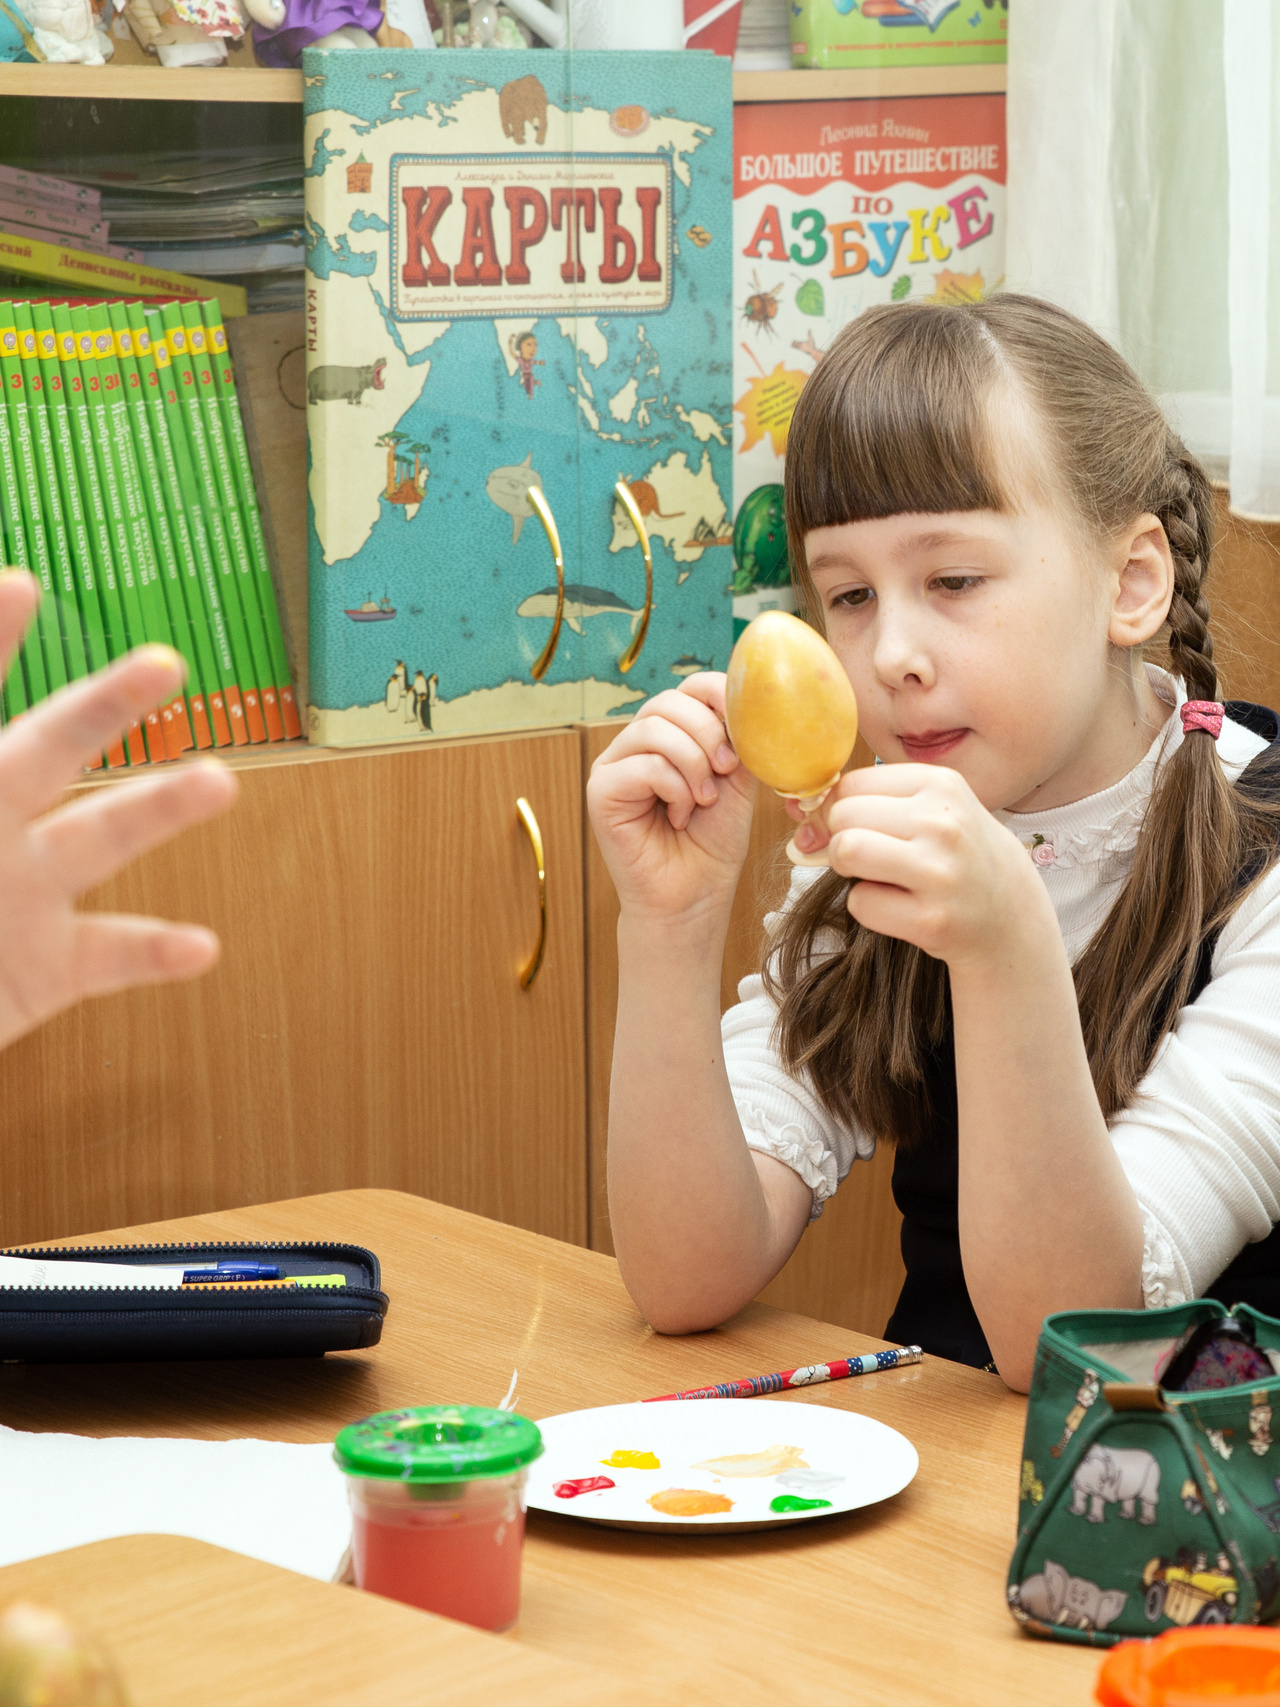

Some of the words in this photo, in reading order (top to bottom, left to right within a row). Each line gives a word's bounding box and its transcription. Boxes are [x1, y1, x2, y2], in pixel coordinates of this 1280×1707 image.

[740, 151, 843, 181] БОЛЬШОЕ
[854, 145, 999, 175] ПУТЕШЕСТВИЕ
[401, 186, 662, 287] КАРТЫ
[742, 185, 994, 278] АЗБУКЕ
[58, 254, 136, 281] Денискины
[139, 275, 199, 296] рассказы
[308, 289, 317, 352] КАРТЫ
[11, 374, 22, 389] 3
[32, 376, 42, 391] 3
[51, 376, 62, 391] 3
[72, 377, 82, 392] 3
[89, 376, 100, 392] 3
[104, 375, 115, 390] 3
[130, 373, 140, 388] 3
[148, 372, 158, 386] 3
[167, 390, 177, 404] 3
[182, 371, 193, 385] 3
[201, 370, 211, 385] 3
[223, 369, 233, 384] 3
[34, 525, 50, 590] искусство
[56, 526, 72, 591] искусство
[76, 525, 93, 590] искусство
[98, 525, 115, 590] искусство
[116, 523, 134, 588] искусство
[158, 516, 176, 579] искусство
[178, 514, 196, 577] искусство
[212, 512, 230, 575] искусство
[230, 511, 248, 574] искусство
[250, 509, 267, 572] искусство
